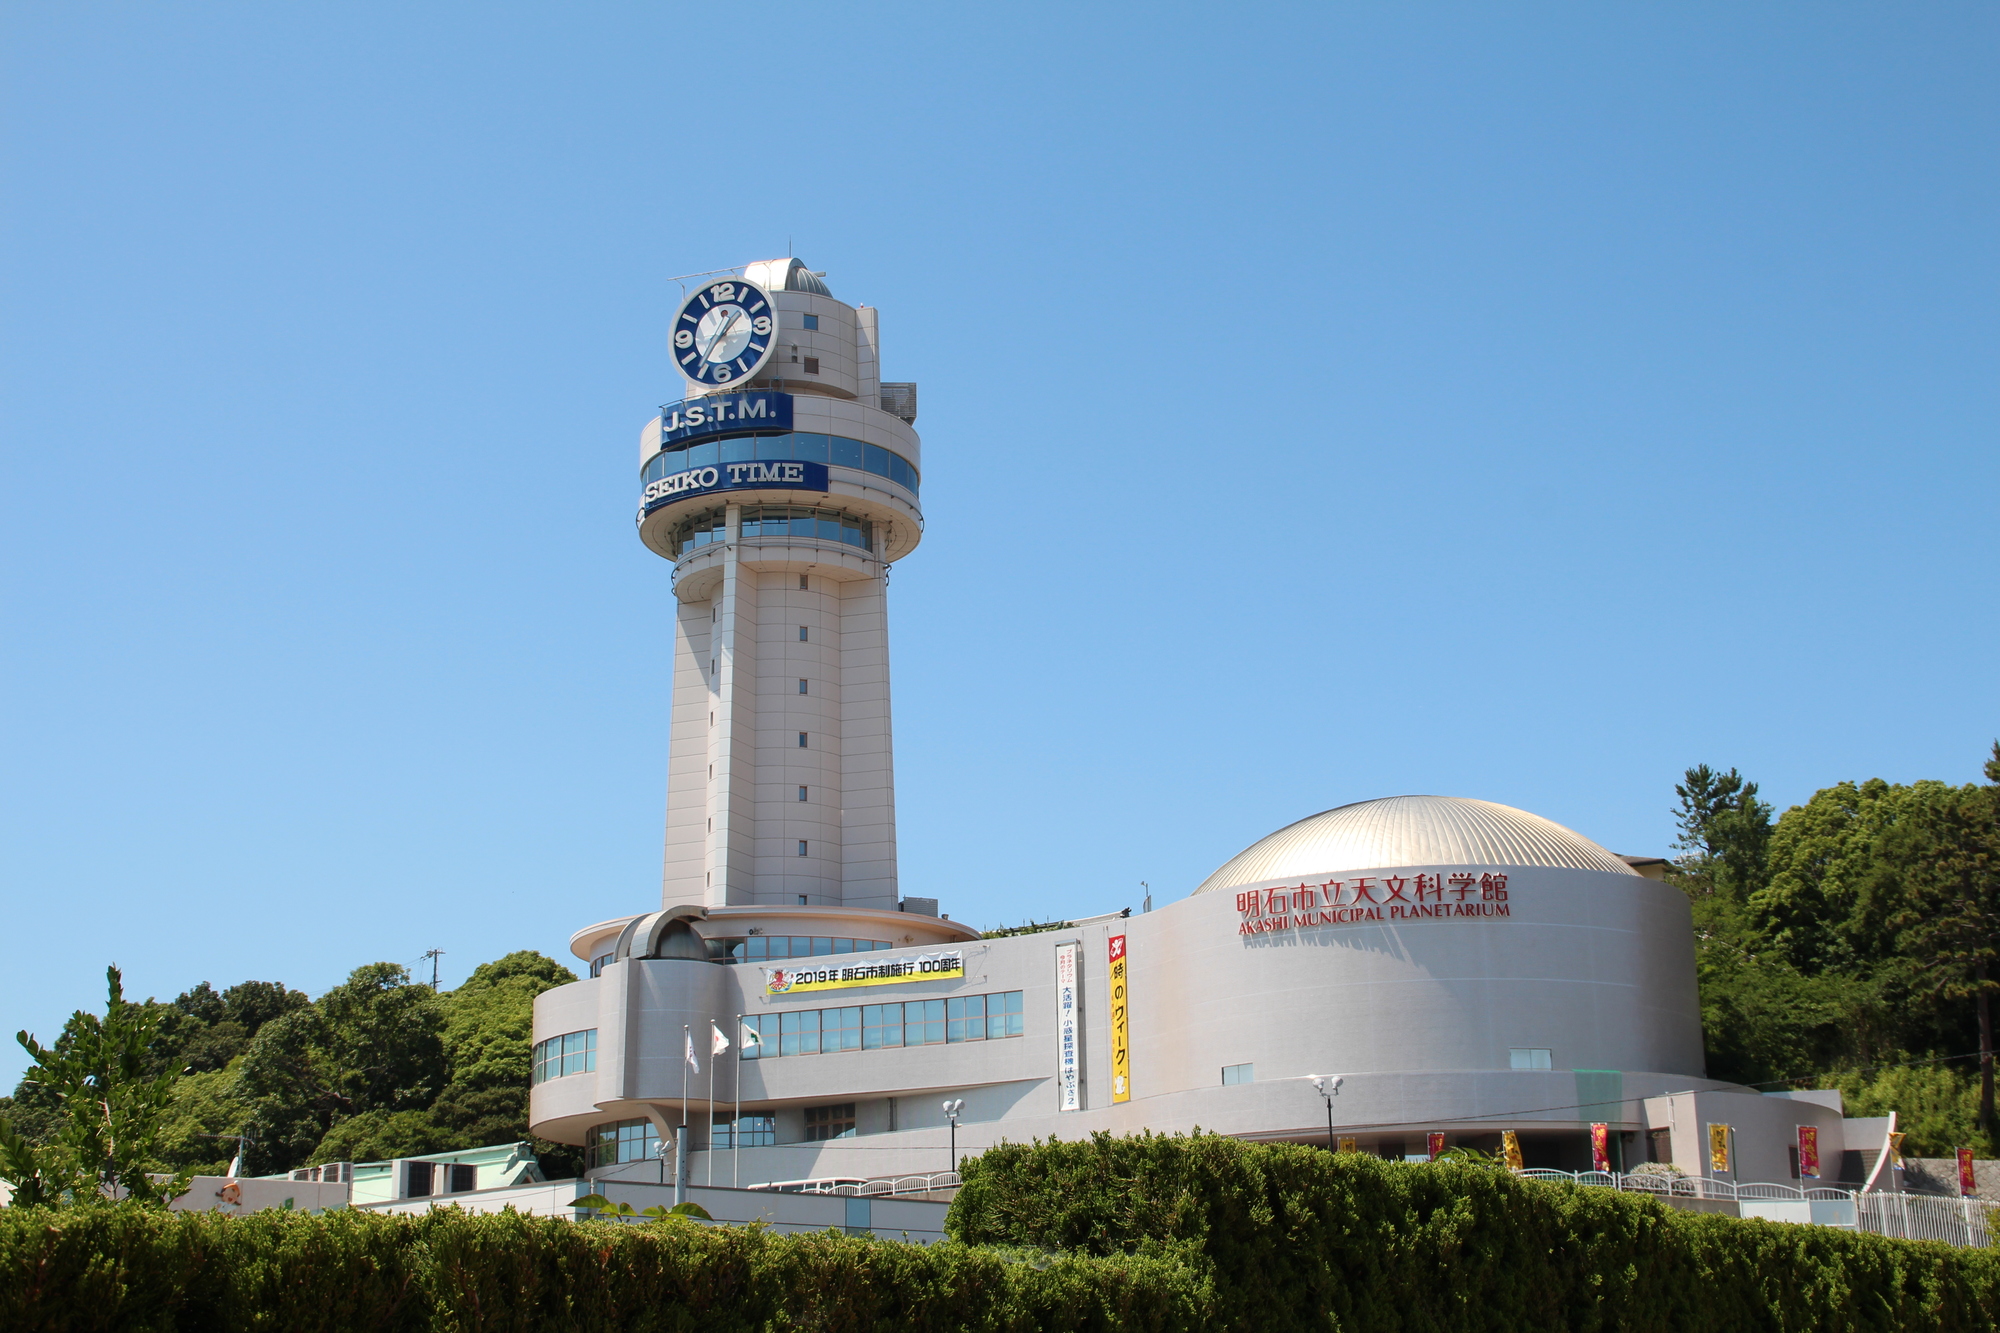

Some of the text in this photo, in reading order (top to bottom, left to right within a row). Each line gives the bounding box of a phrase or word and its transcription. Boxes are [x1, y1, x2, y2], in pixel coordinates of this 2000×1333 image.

[710, 283, 735, 302] 12
[675, 330, 693, 348] 9
[753, 316, 772, 336] 3
[714, 364, 732, 382] 6
[663, 399, 776, 433] J.S.T.M.
[645, 463, 804, 503] SEIKO TIME
[1236, 872, 1508, 919] 明石市立天文科学館
[1238, 903, 1510, 935] AKASHI MUNICIPAL PLANETARIUM
[795, 958, 961, 984] 2019年 明石市制施行 100周年
